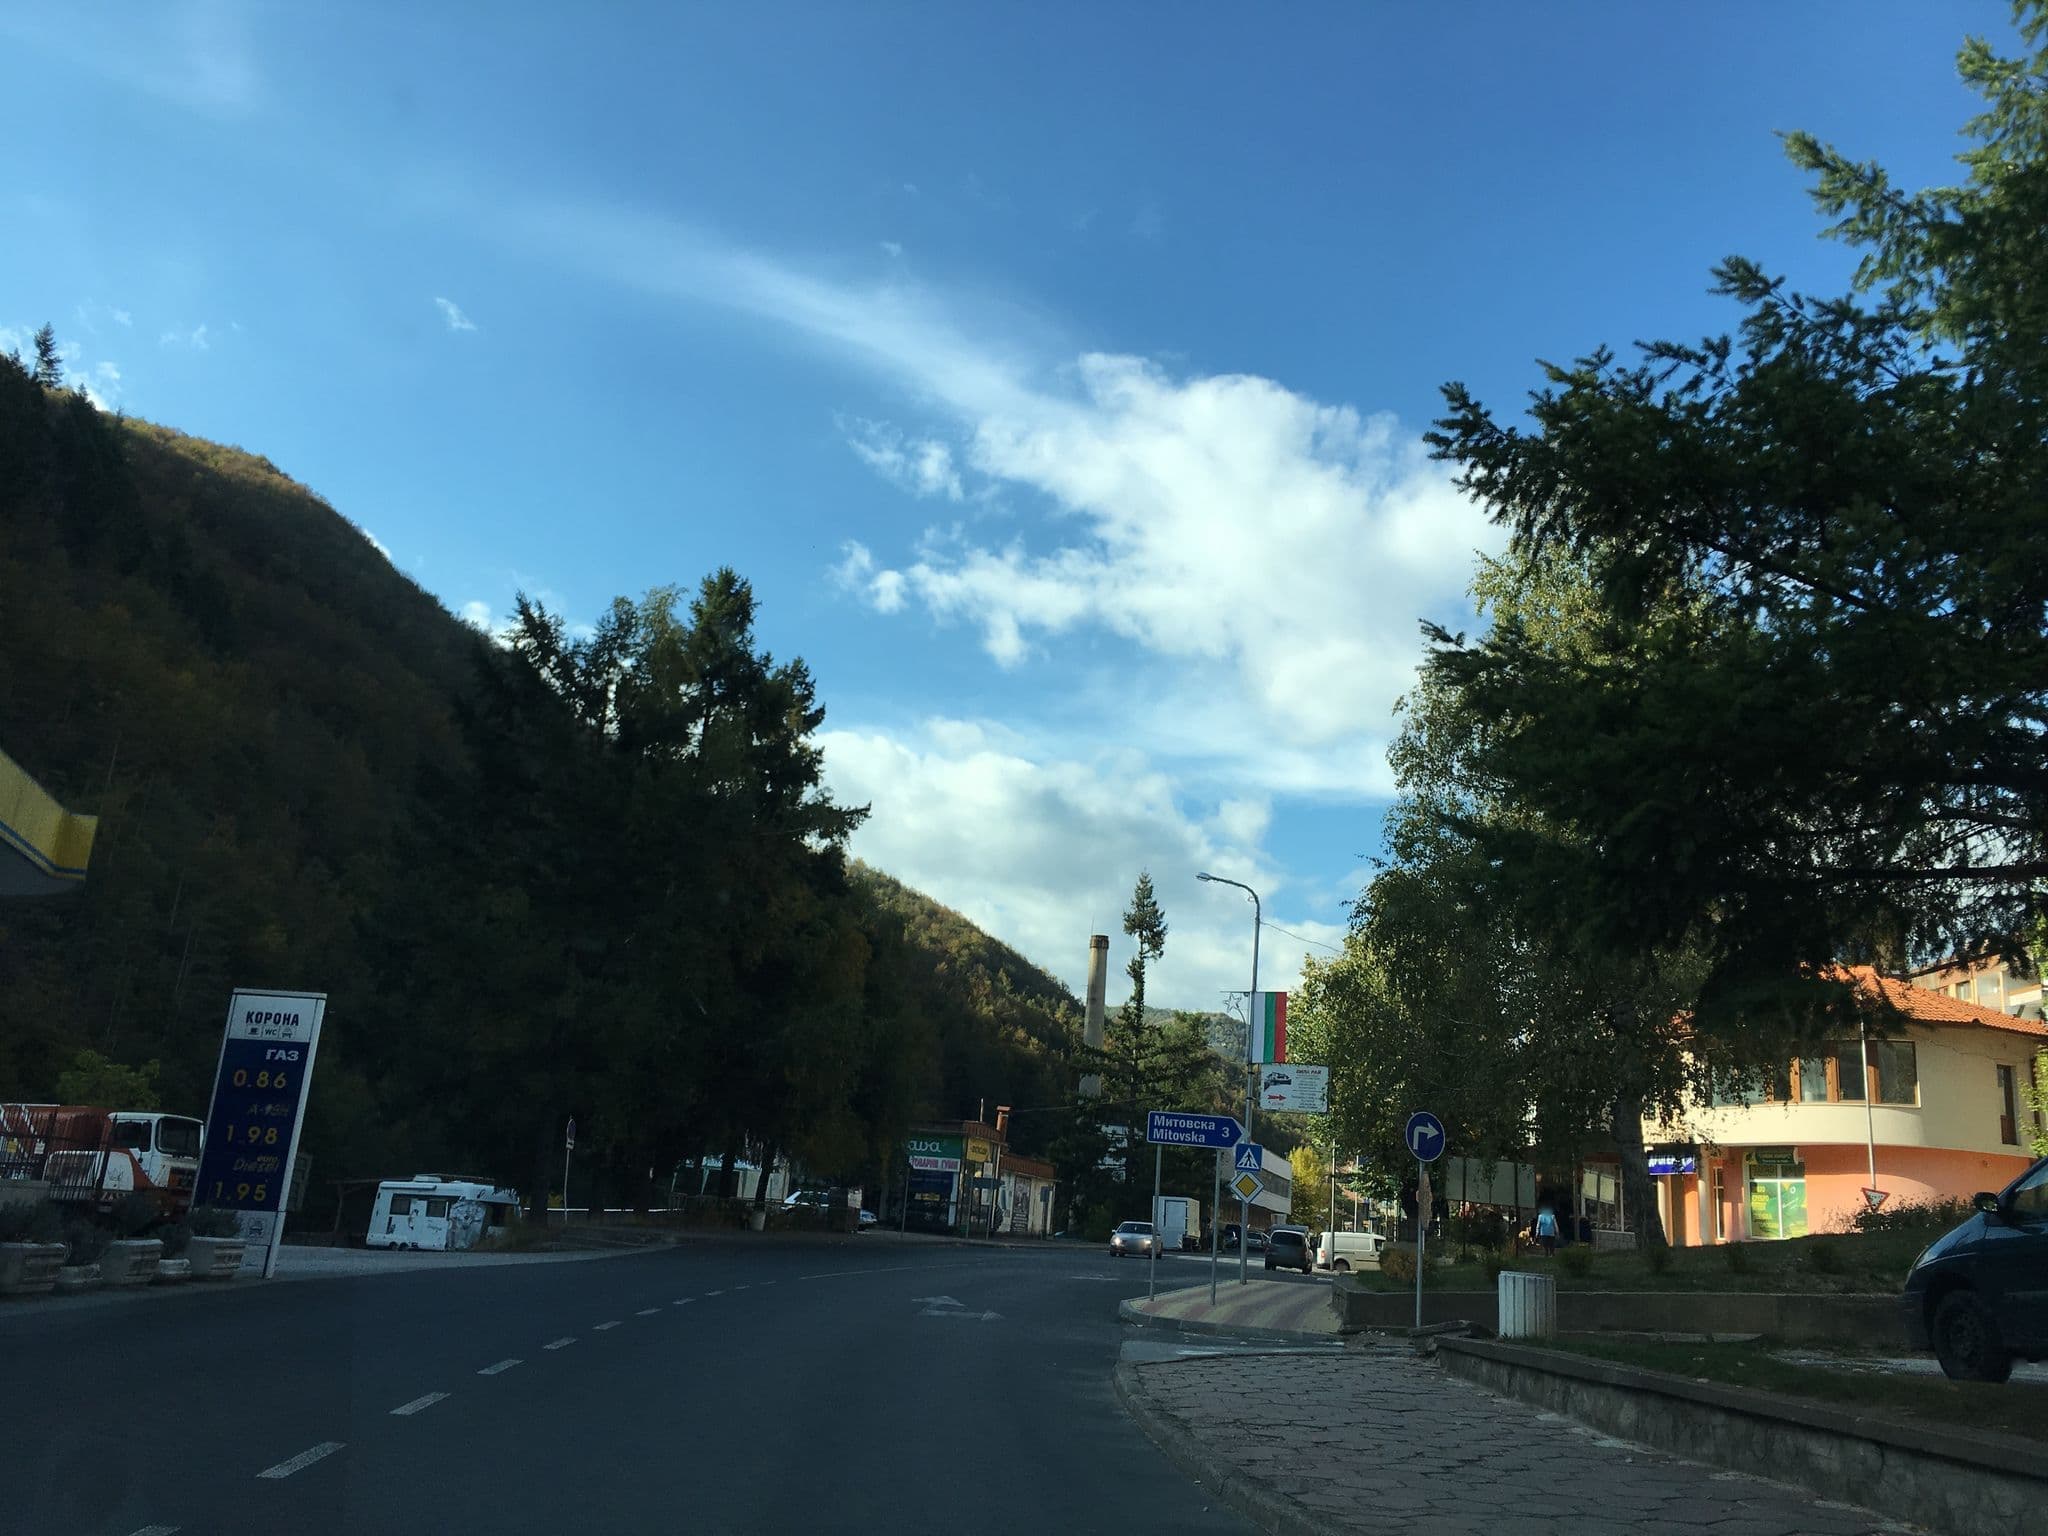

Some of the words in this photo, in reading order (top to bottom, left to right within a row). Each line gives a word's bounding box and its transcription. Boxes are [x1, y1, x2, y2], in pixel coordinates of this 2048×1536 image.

[246, 1011, 299, 1026] КОРОНА
[265, 1048, 299, 1062] ГАЗ
[233, 1068, 287, 1089] 0.86
[1154, 1115, 1216, 1131] Митовска
[226, 1124, 279, 1145] 1.98
[1153, 1128, 1206, 1143] Mitovska
[1221, 1126, 1231, 1138] 3
[215, 1180, 267, 1202] 1.95
